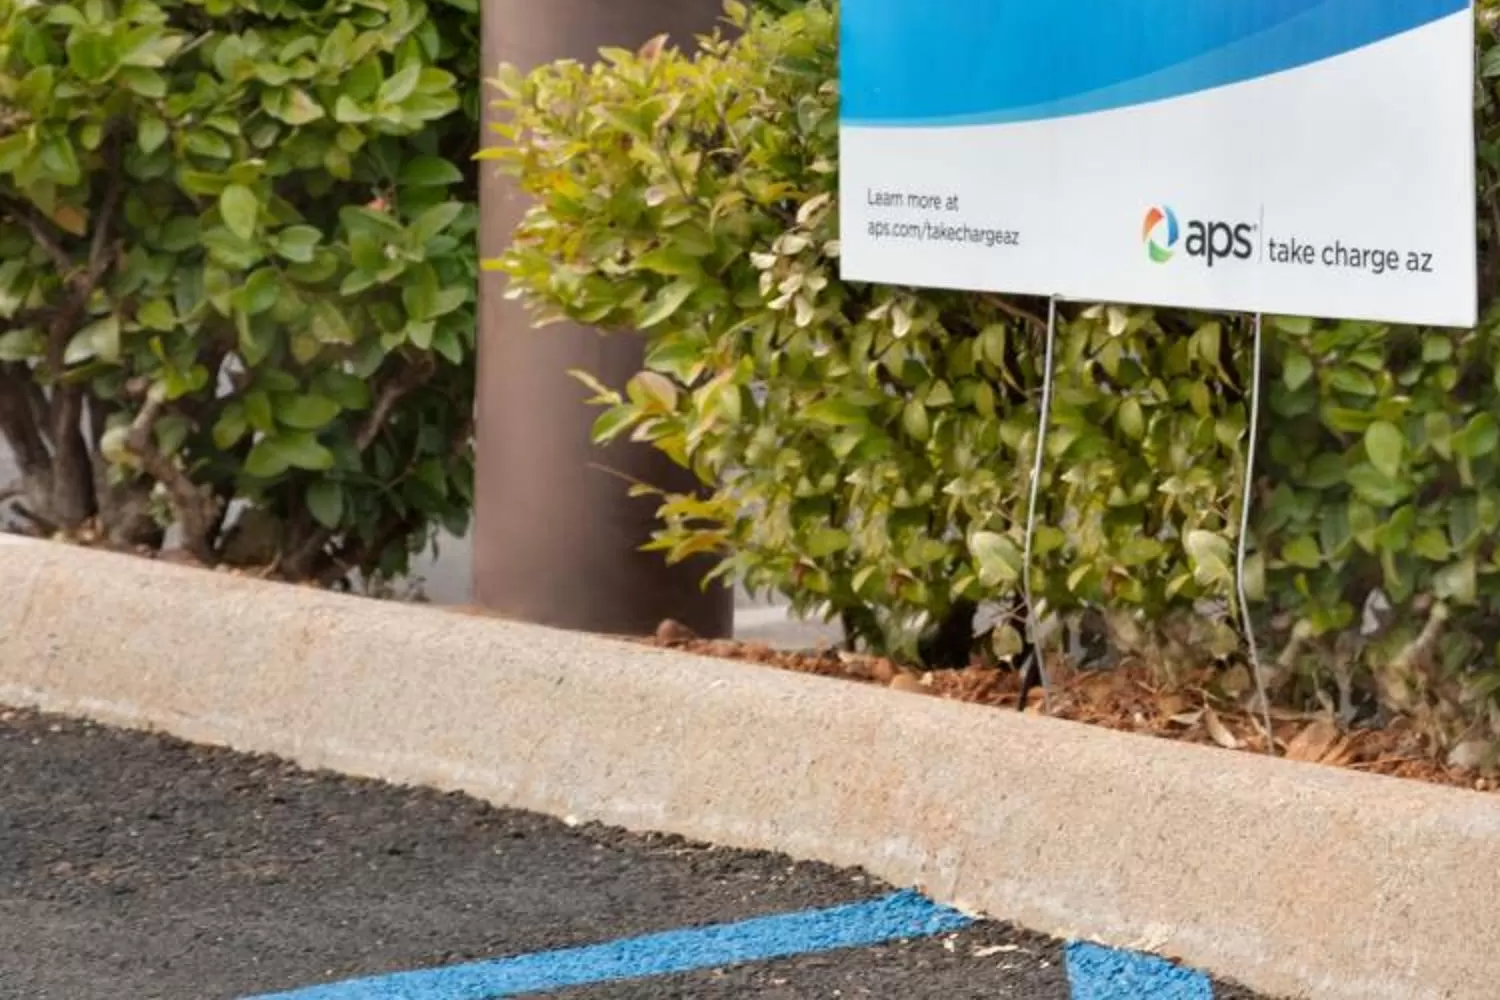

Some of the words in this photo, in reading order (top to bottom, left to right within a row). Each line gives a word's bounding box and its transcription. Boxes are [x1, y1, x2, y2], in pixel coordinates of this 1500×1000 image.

[867, 187, 904, 207] Learn
[907, 193, 942, 210] more
[945, 193, 960, 212] at
[867, 219, 1020, 248] aps.com/takechargeaz
[1185, 220, 1254, 267] aps
[1268, 237, 1315, 264] take
[1321, 240, 1399, 274] charge
[1405, 251, 1433, 273] az
